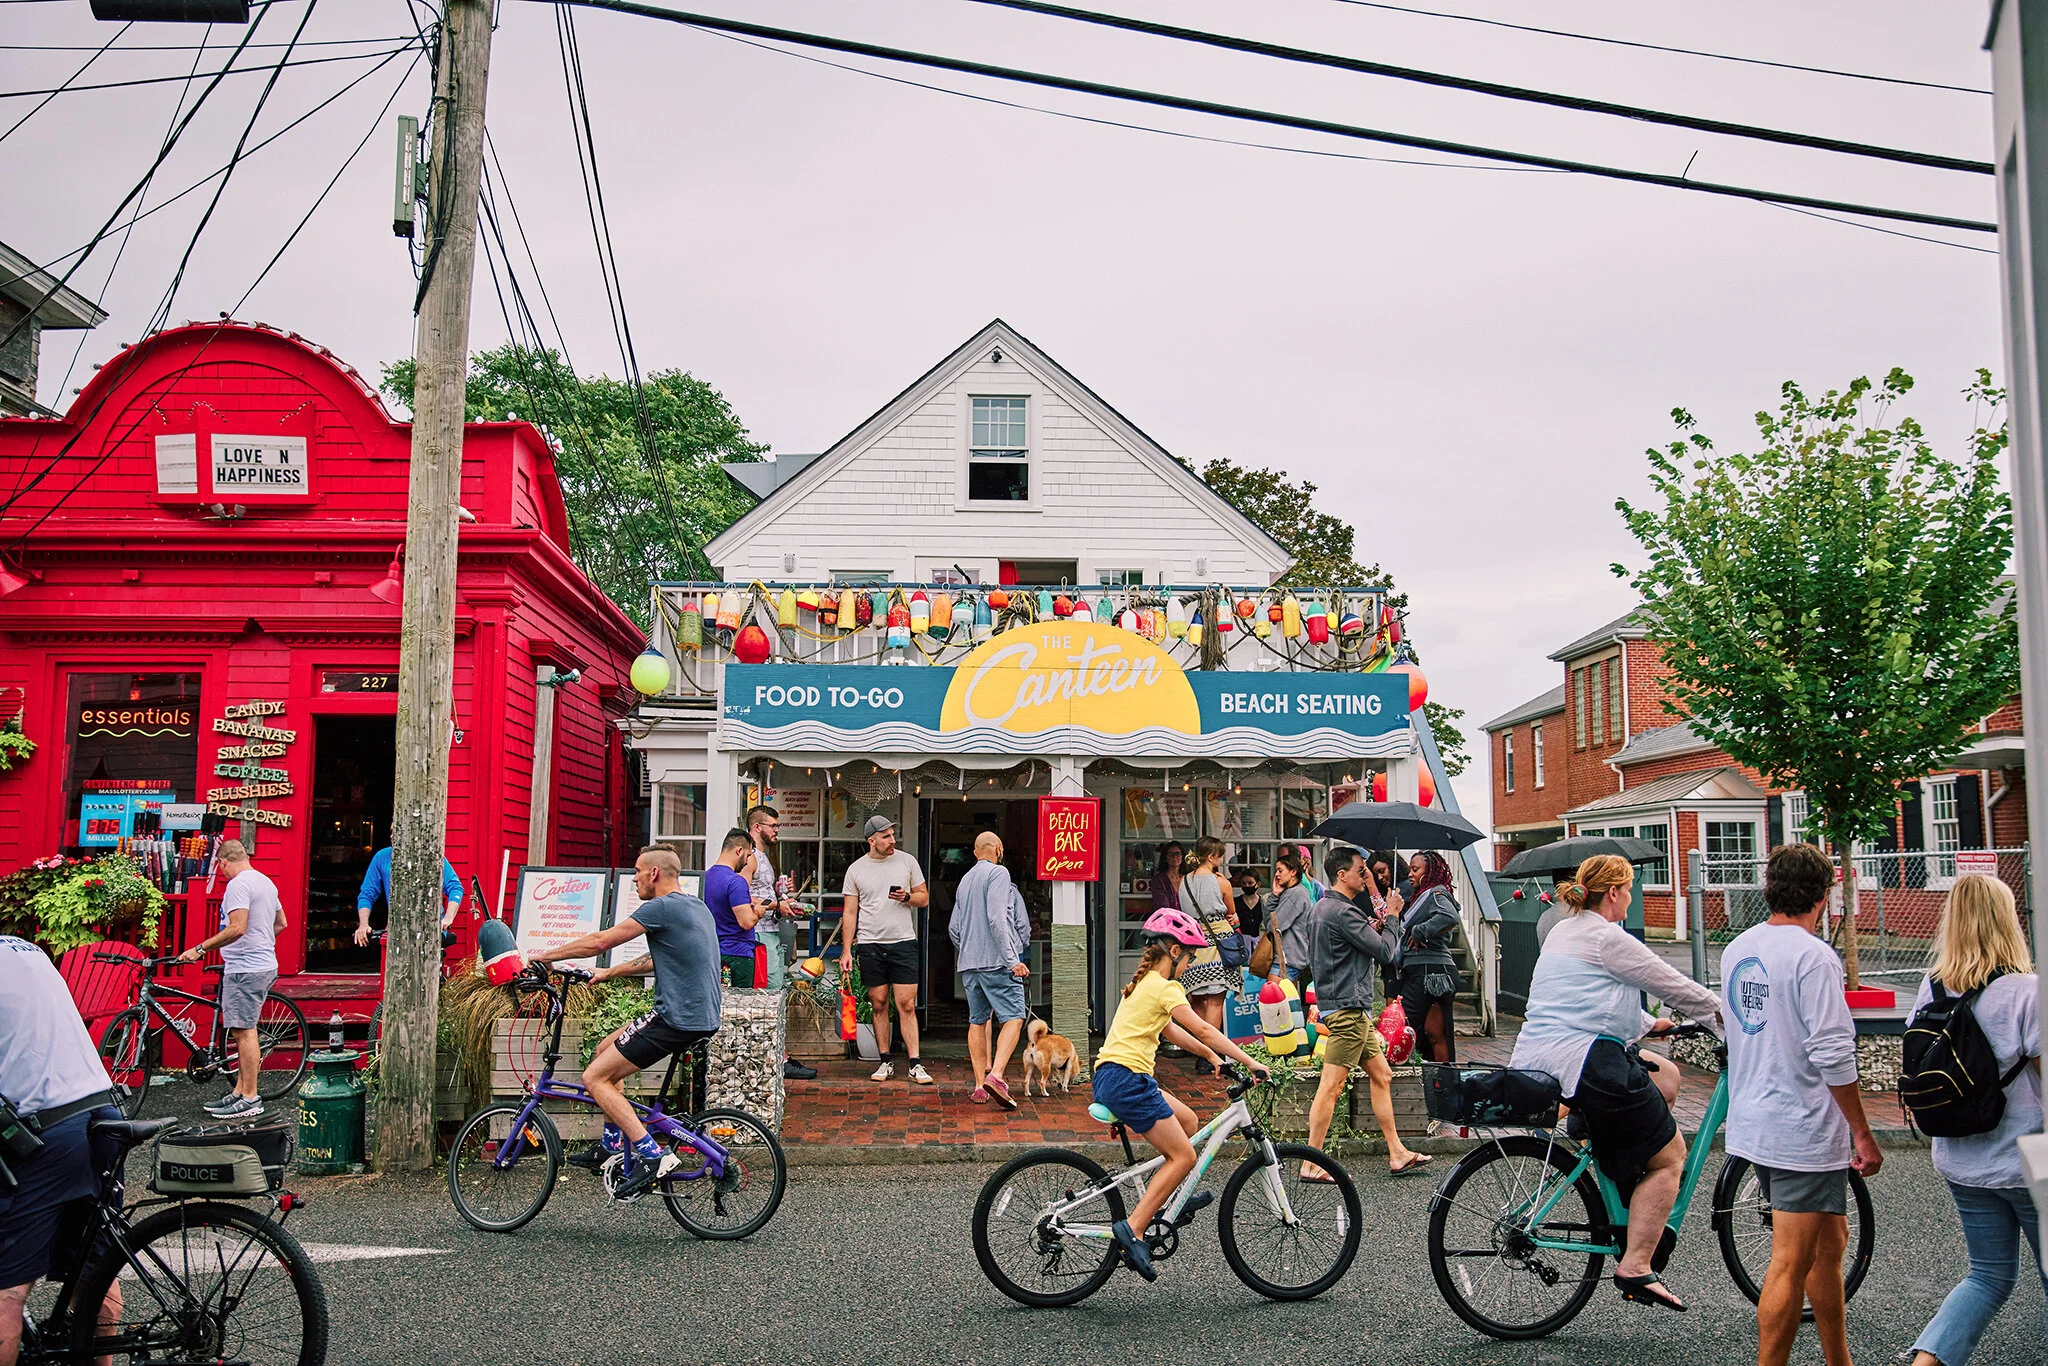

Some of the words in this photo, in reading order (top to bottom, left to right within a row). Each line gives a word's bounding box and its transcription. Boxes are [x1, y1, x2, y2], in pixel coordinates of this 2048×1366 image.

[224, 448, 263, 464] LOVE
[279, 449, 289, 464] N
[217, 467, 300, 483] HAPPINESS
[1041, 635, 1073, 649] THE
[362, 676, 388, 688] 227
[964, 636, 1163, 727] Canteen
[755, 685, 821, 707] FOOD
[827, 686, 904, 709] TO-GO
[1220, 693, 1289, 714] BEACH
[1296, 693, 1382, 715] SEATING
[81, 707, 191, 725] essentials
[225, 701, 286, 718] CANDY
[212, 718, 297, 743] BANANAS
[217, 743, 286, 760] SNACKS
[216, 764, 287, 782] COFFEE
[83, 780, 138, 789] CONVENIENCE
[145, 780, 170, 788] STORE
[208, 782, 291, 802] SLUSHIES
[208, 802, 238, 818] POP
[243, 808, 290, 827] CORN
[1049, 812, 1089, 830] BEACH
[88, 819, 120, 834] 375
[1054, 831, 1087, 852] BAR
[1045, 856, 1084, 877] Open
[533, 877, 592, 901] Canteen
[170, 1165, 219, 1180] POLICE
